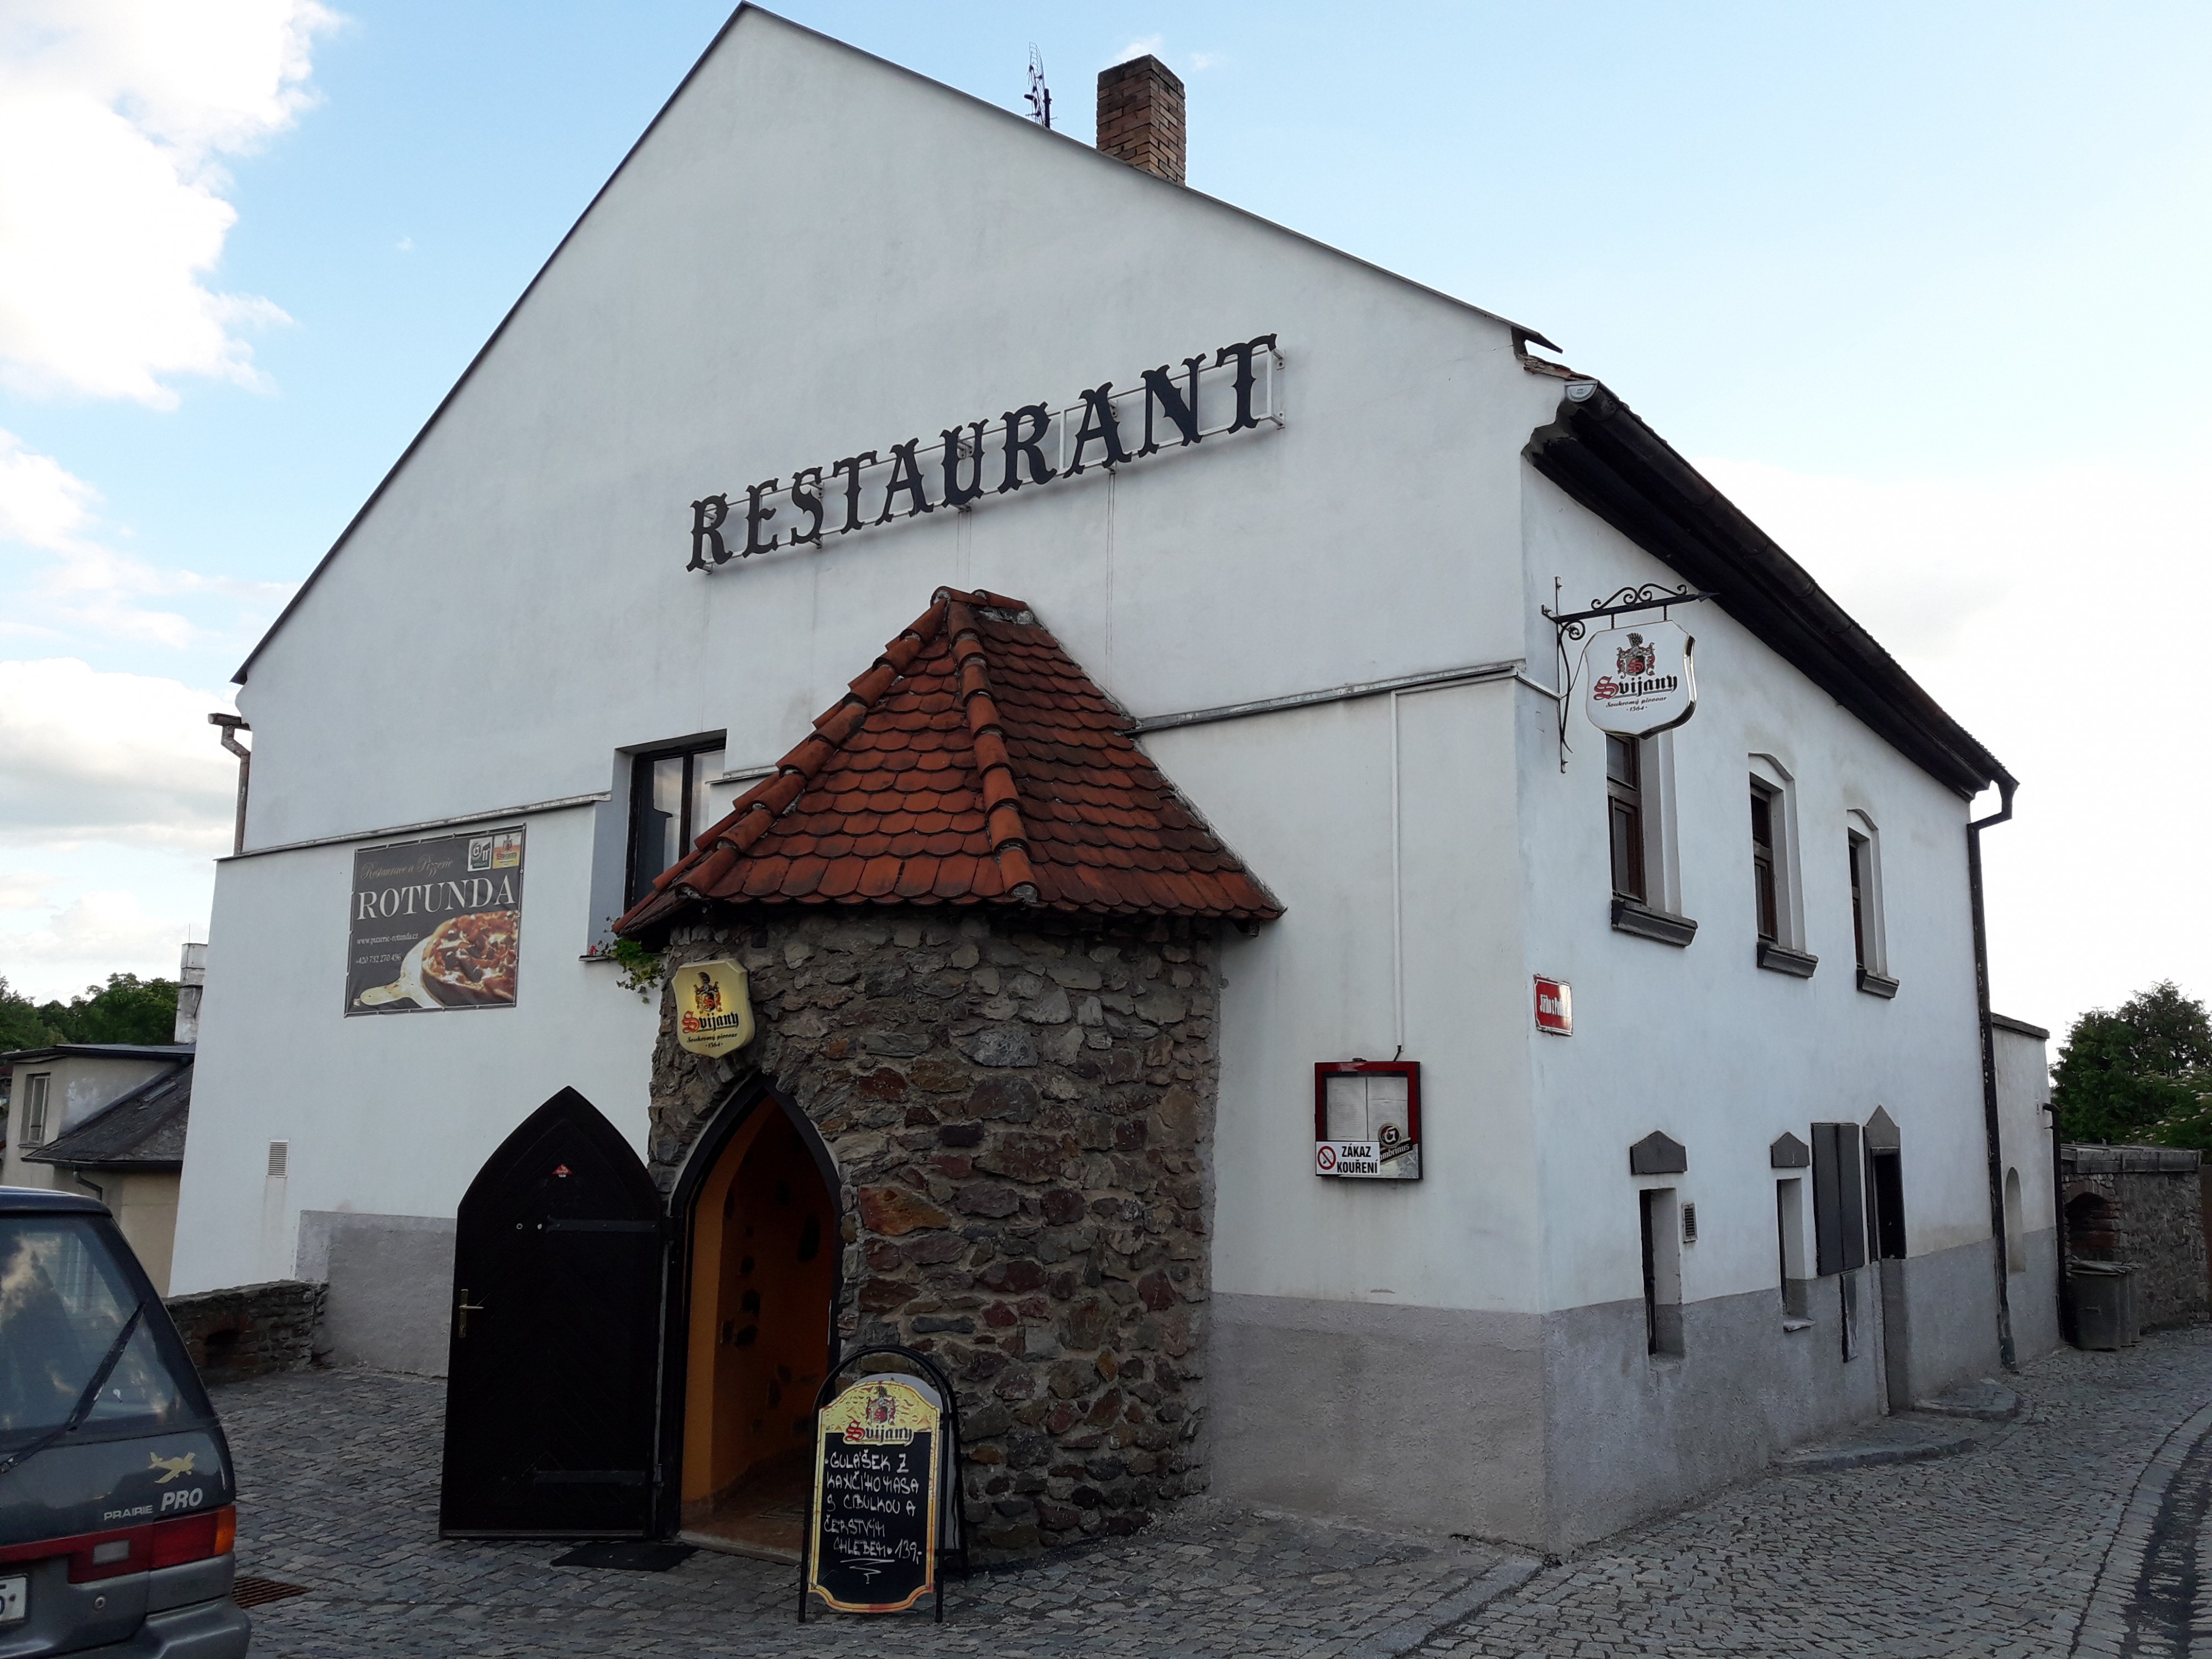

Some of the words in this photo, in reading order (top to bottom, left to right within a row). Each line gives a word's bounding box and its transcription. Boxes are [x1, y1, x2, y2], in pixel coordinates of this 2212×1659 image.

[686, 333, 1277, 572] RESTAURANT
[1593, 674, 1677, 701] Svijany
[1605, 698, 1639, 708] Soukromý
[356, 875, 516, 920] ROTUNDA
[682, 1010, 739, 1034] Svijany
[1342, 1143, 1371, 1157] ZÁKAZ
[1337, 1159, 1378, 1174] KOUŘENÍ
[844, 1420, 913, 1444] Svijany
[896, 1453, 909, 1473] Z
[883, 1475, 919, 1494] MASA
[103, 1504, 154, 1521] PRAIRIE
[160, 1488, 204, 1512] PRO
[906, 1500, 916, 1517] A
